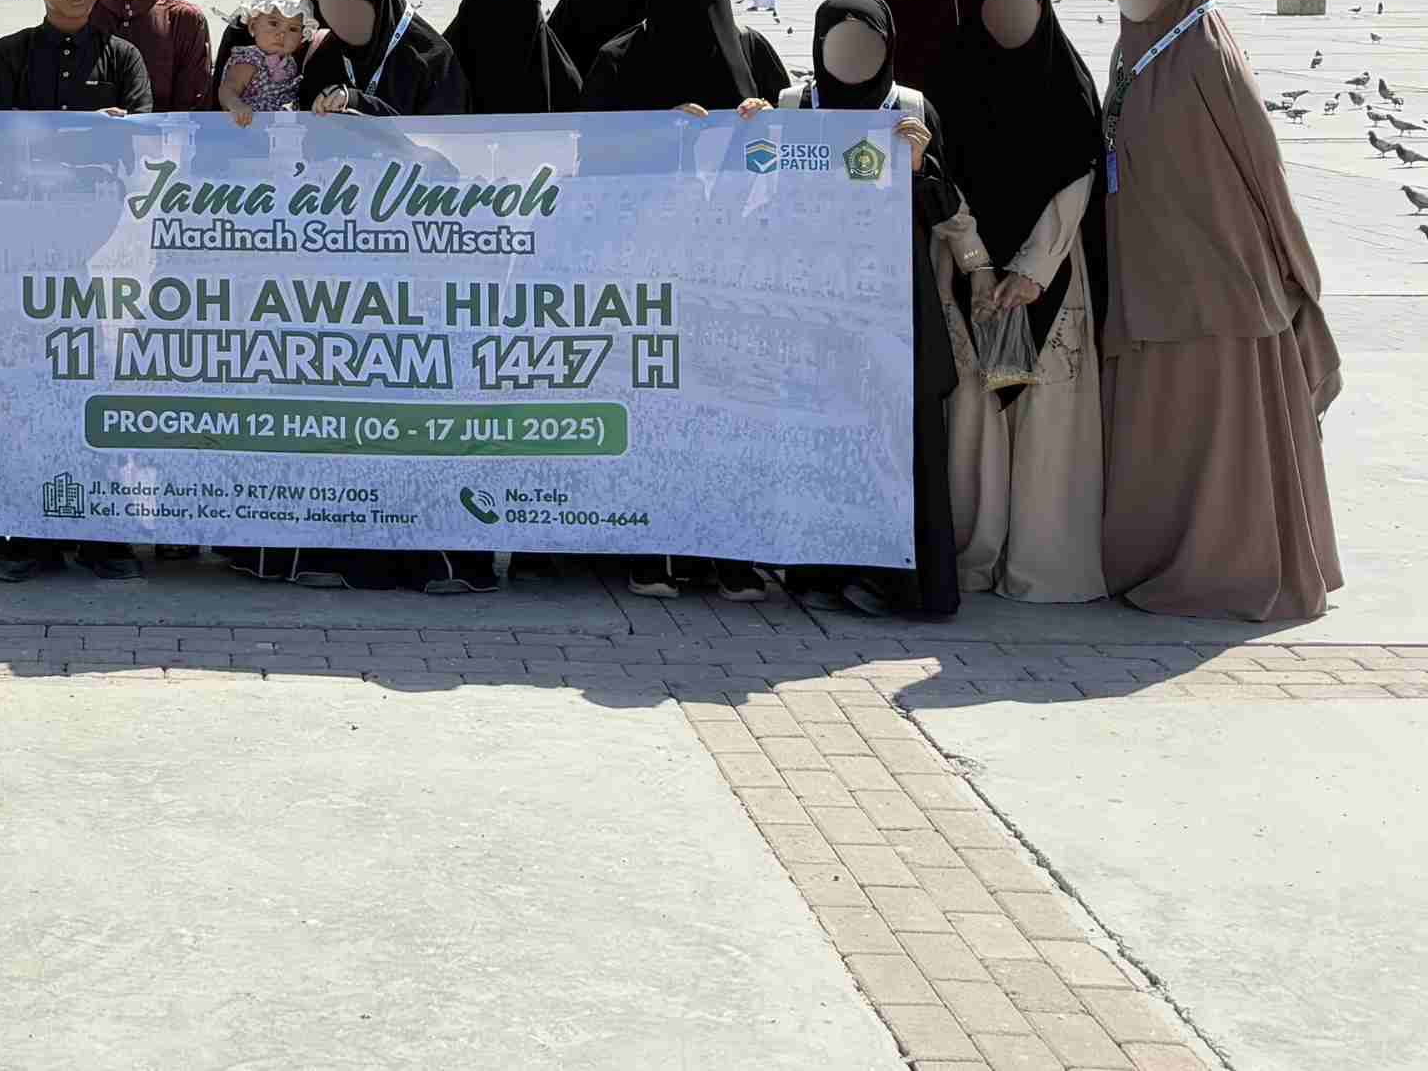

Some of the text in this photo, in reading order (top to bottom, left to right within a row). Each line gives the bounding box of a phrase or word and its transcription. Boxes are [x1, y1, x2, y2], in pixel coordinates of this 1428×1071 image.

[780, 144, 830, 159] SISKO
[780, 159, 830, 171] PATUH
[371, 161, 560, 223] Umroh
[151, 218, 535, 255] Madinah Salam Wisata
[22, 276, 673, 328] UMROH AWAL HIJRIAH
[45, 326, 680, 390] 11 MUHARRAM 1447 H
[103, 410, 240, 436] PROGRAM
[246, 413, 275, 436] 12
[283, 414, 346, 439] HARI
[354, 417, 400, 445] (06
[424, 418, 455, 441] 17
[460, 418, 513, 441] JULI
[522, 417, 605, 446] 2025)
[89, 481, 379, 503] Jl. Radar Auri No. 9 RT/RW 013/005
[505, 488, 568, 505] No.Telp
[90, 503, 418, 524] Kel. Cibubur, Kec. Ciracas, Jakarta Timur
[505, 510, 650, 526] 0822-1000-4644
